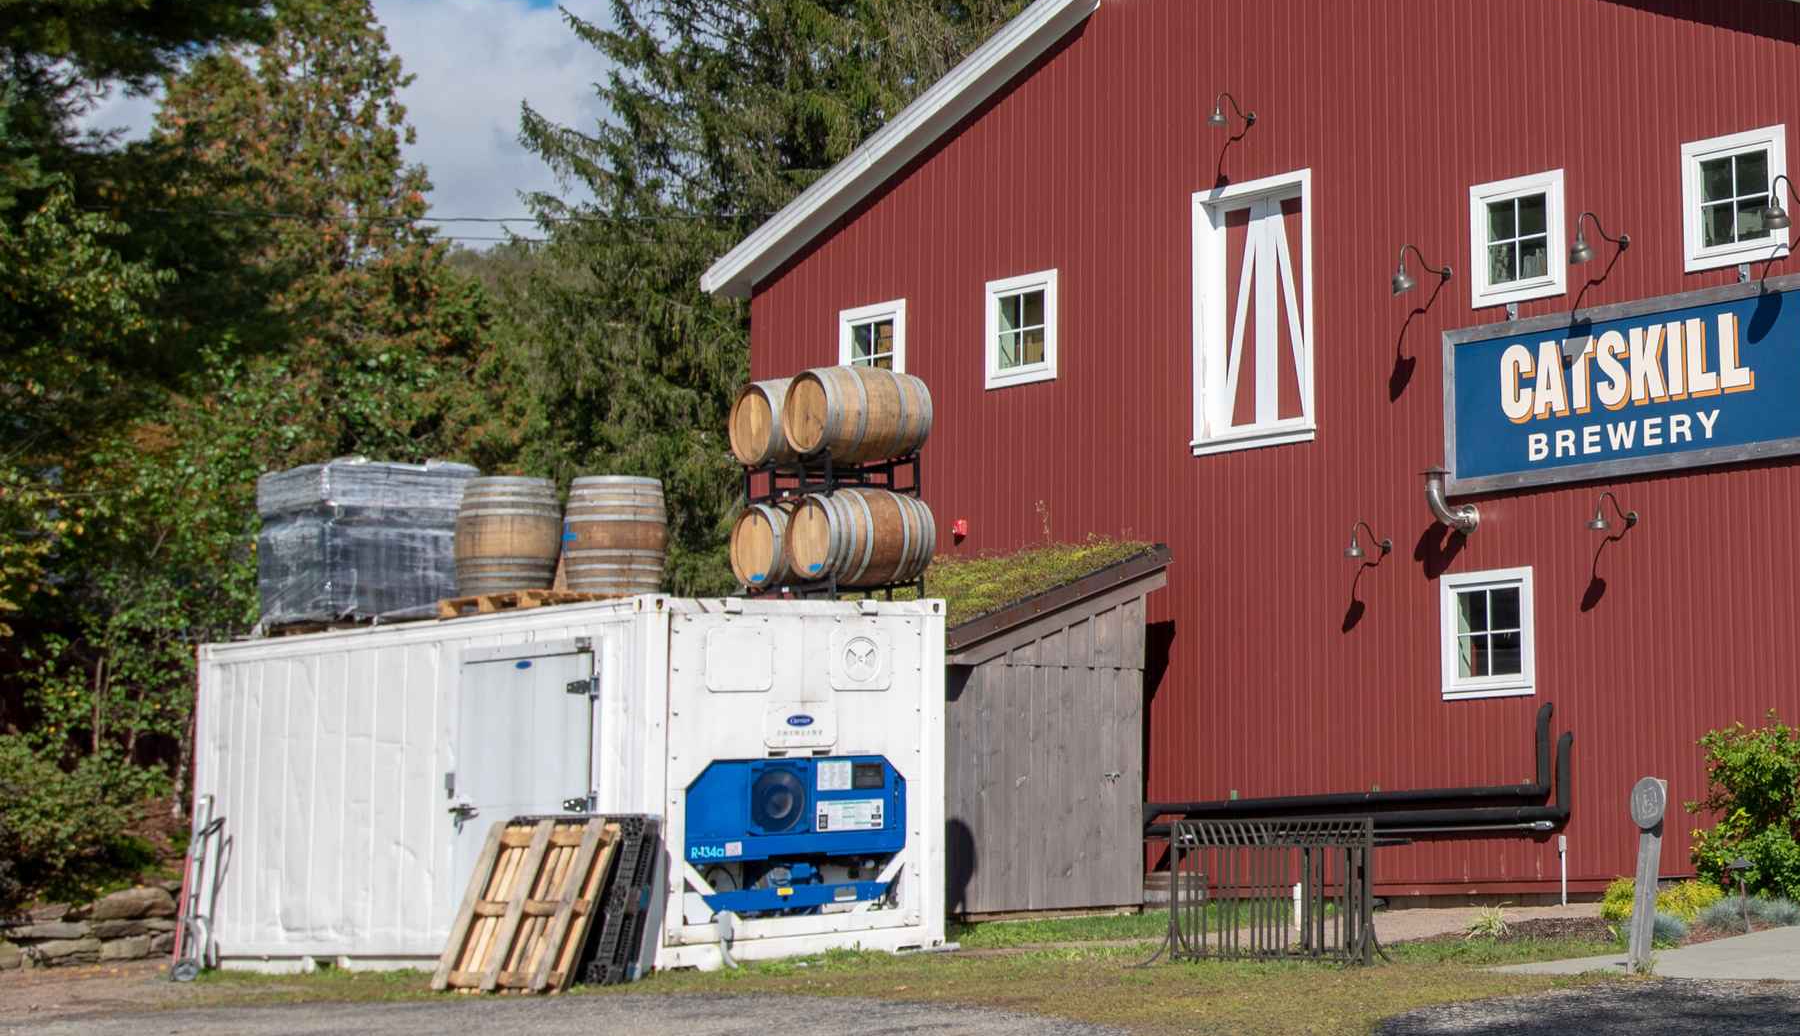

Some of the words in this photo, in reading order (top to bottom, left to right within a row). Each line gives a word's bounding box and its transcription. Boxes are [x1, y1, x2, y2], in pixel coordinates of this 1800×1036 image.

[1500, 312, 1755, 424] CATSKILL
[1528, 409, 1720, 462] BREWERY
[691, 845, 724, 859] R-134a
